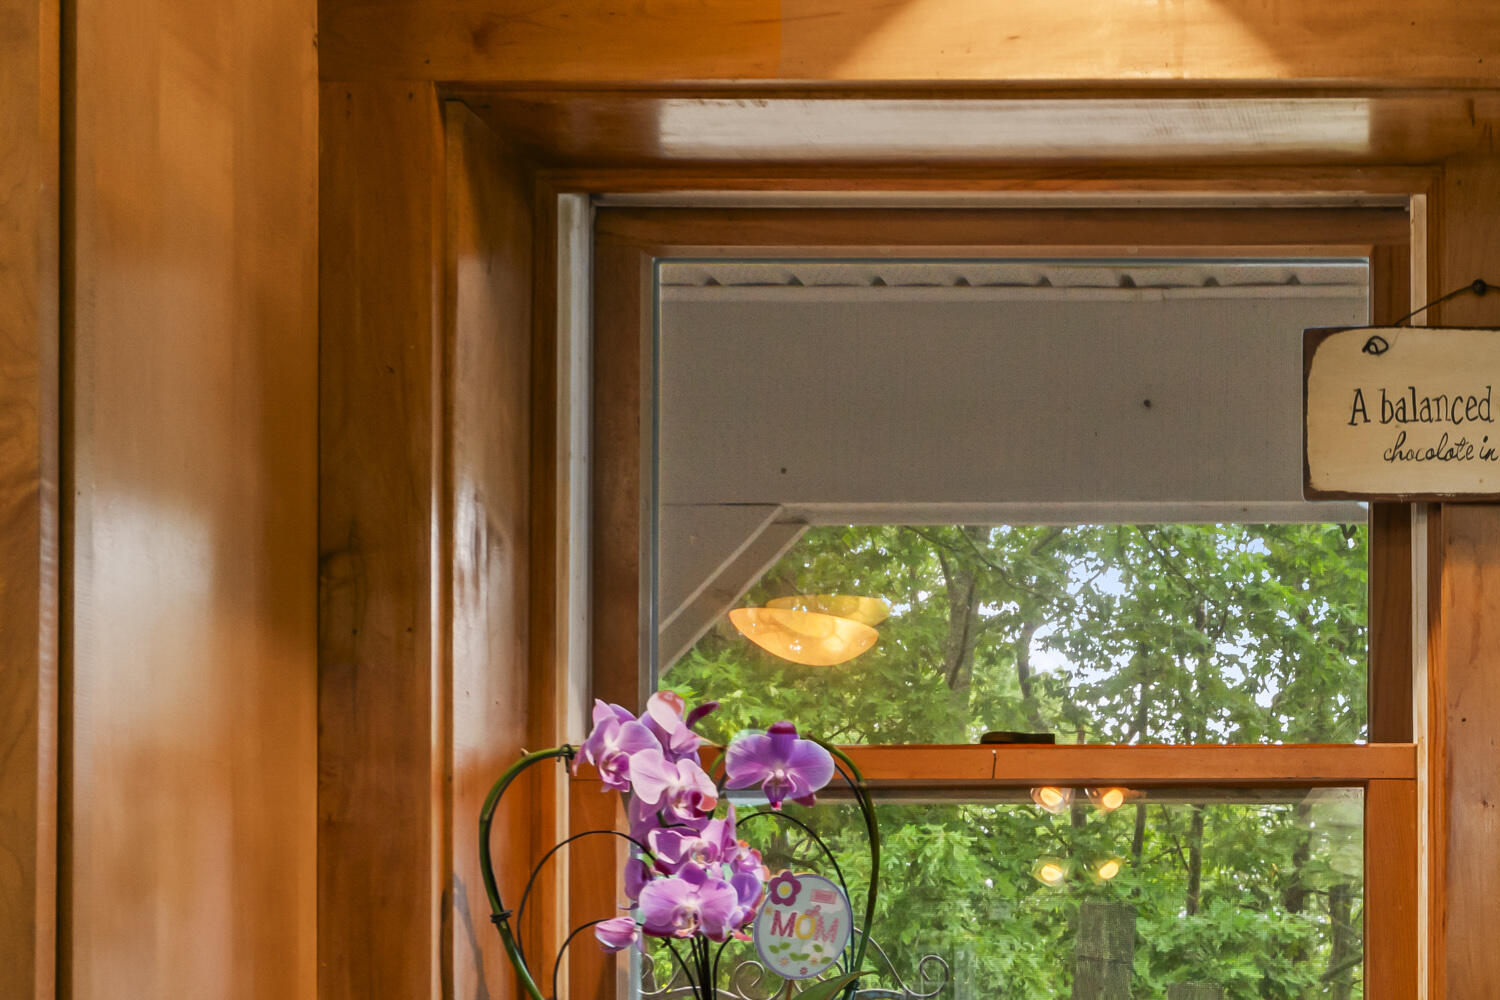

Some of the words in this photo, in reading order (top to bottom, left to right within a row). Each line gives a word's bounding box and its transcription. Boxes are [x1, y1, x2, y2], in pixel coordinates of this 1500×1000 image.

[1347, 387, 1371, 426] A
[1378, 386, 1495, 425] balanced
[1383, 430, 1475, 463] chocolate
[1478, 435, 1499, 462] in
[770, 909, 839, 943] MOM
